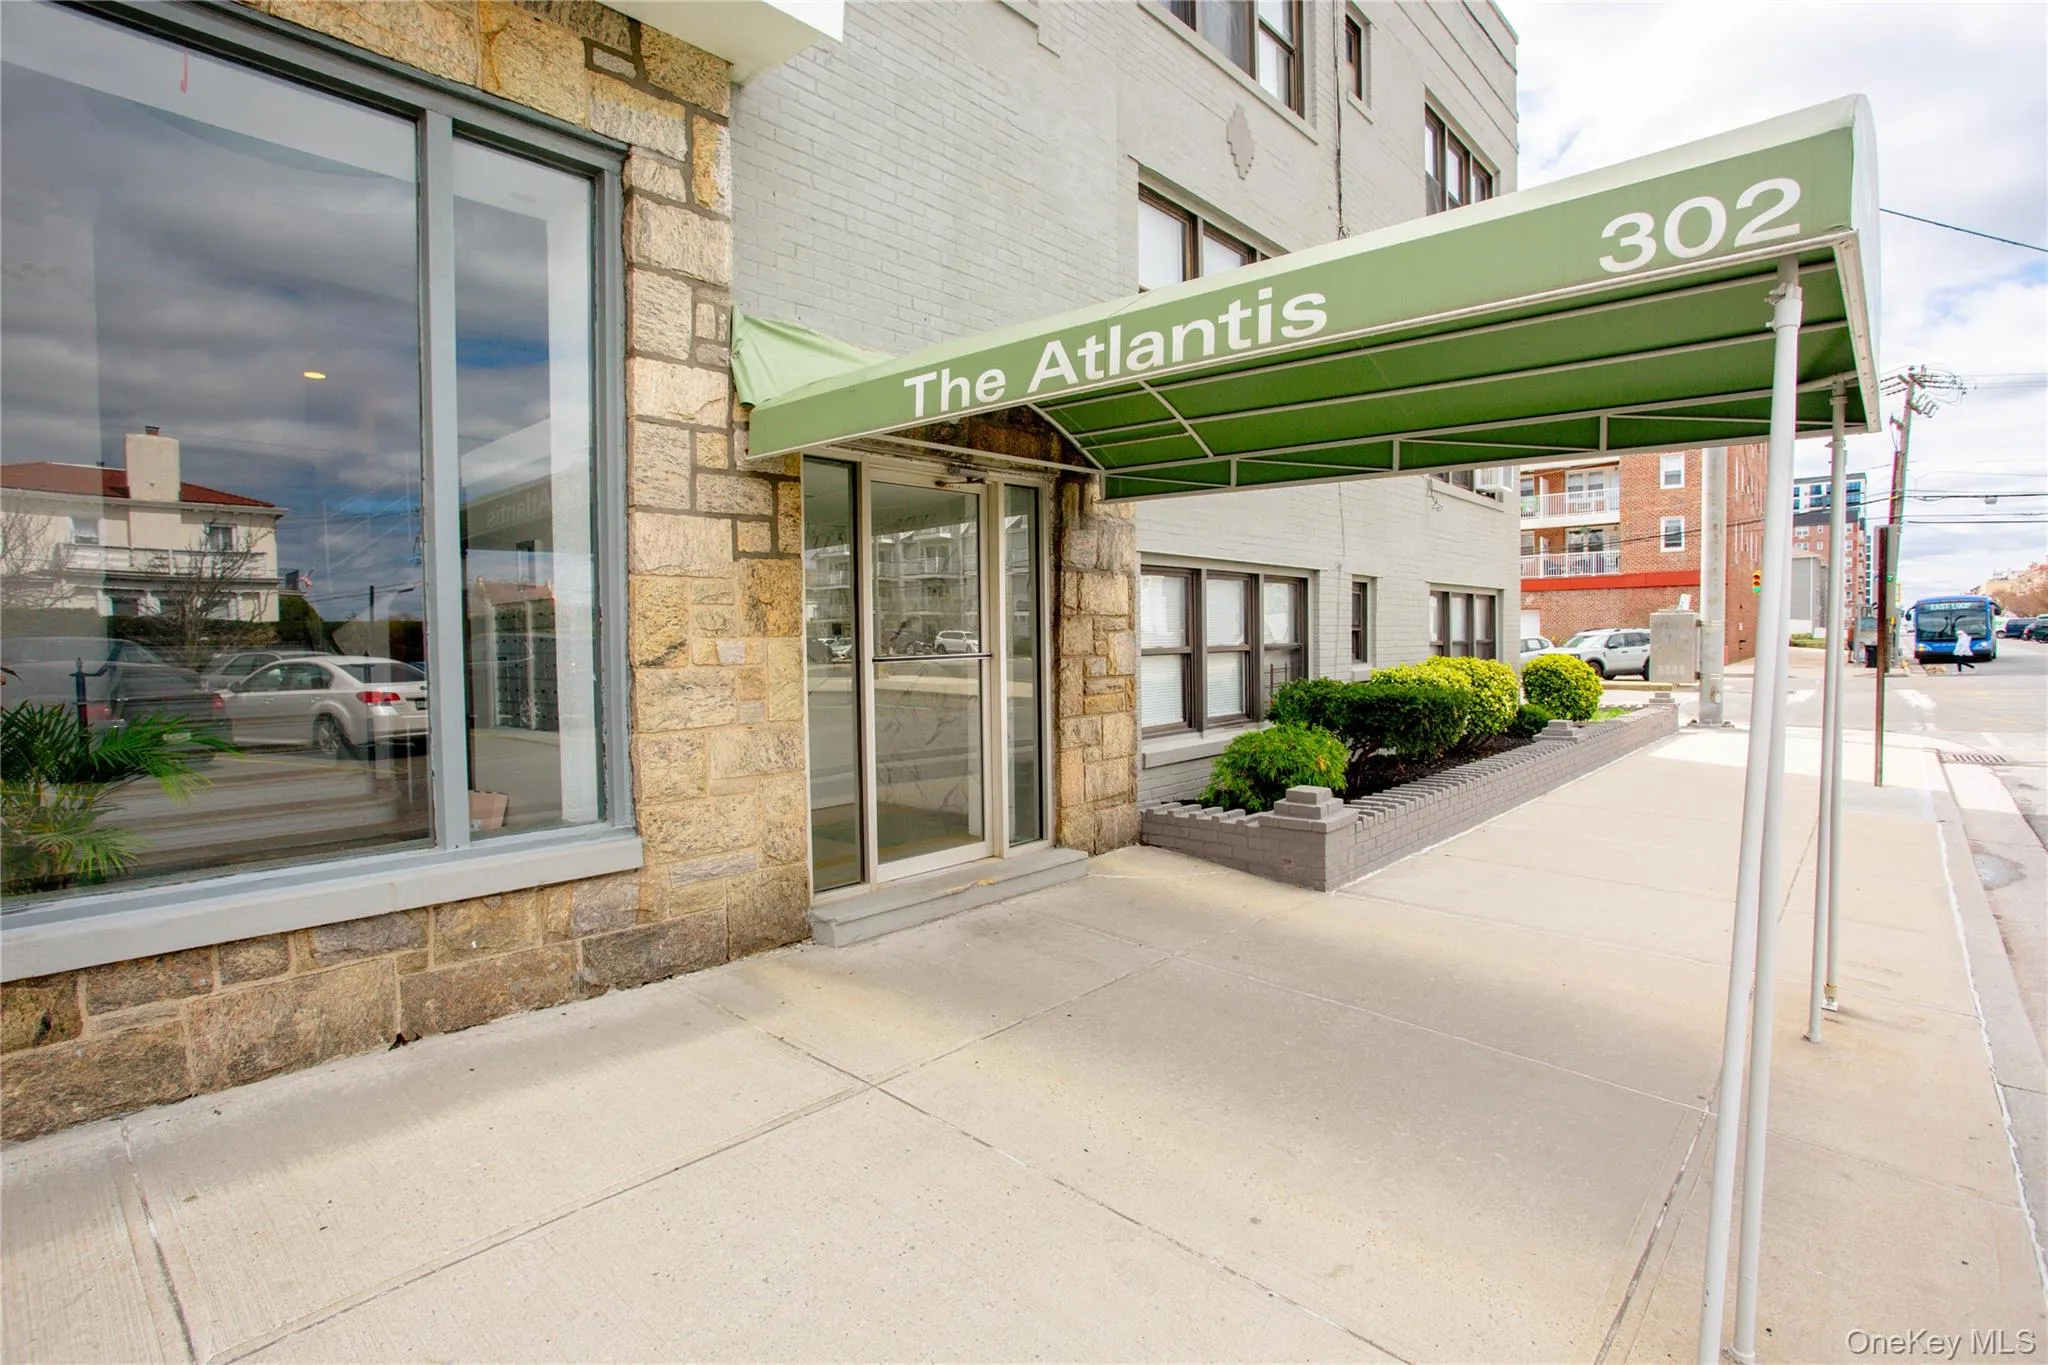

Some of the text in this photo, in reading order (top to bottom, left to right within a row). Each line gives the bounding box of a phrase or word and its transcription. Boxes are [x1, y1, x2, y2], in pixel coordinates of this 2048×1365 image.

[1599, 177, 1801, 273] 302
[903, 287, 1328, 418] The Atlantis
